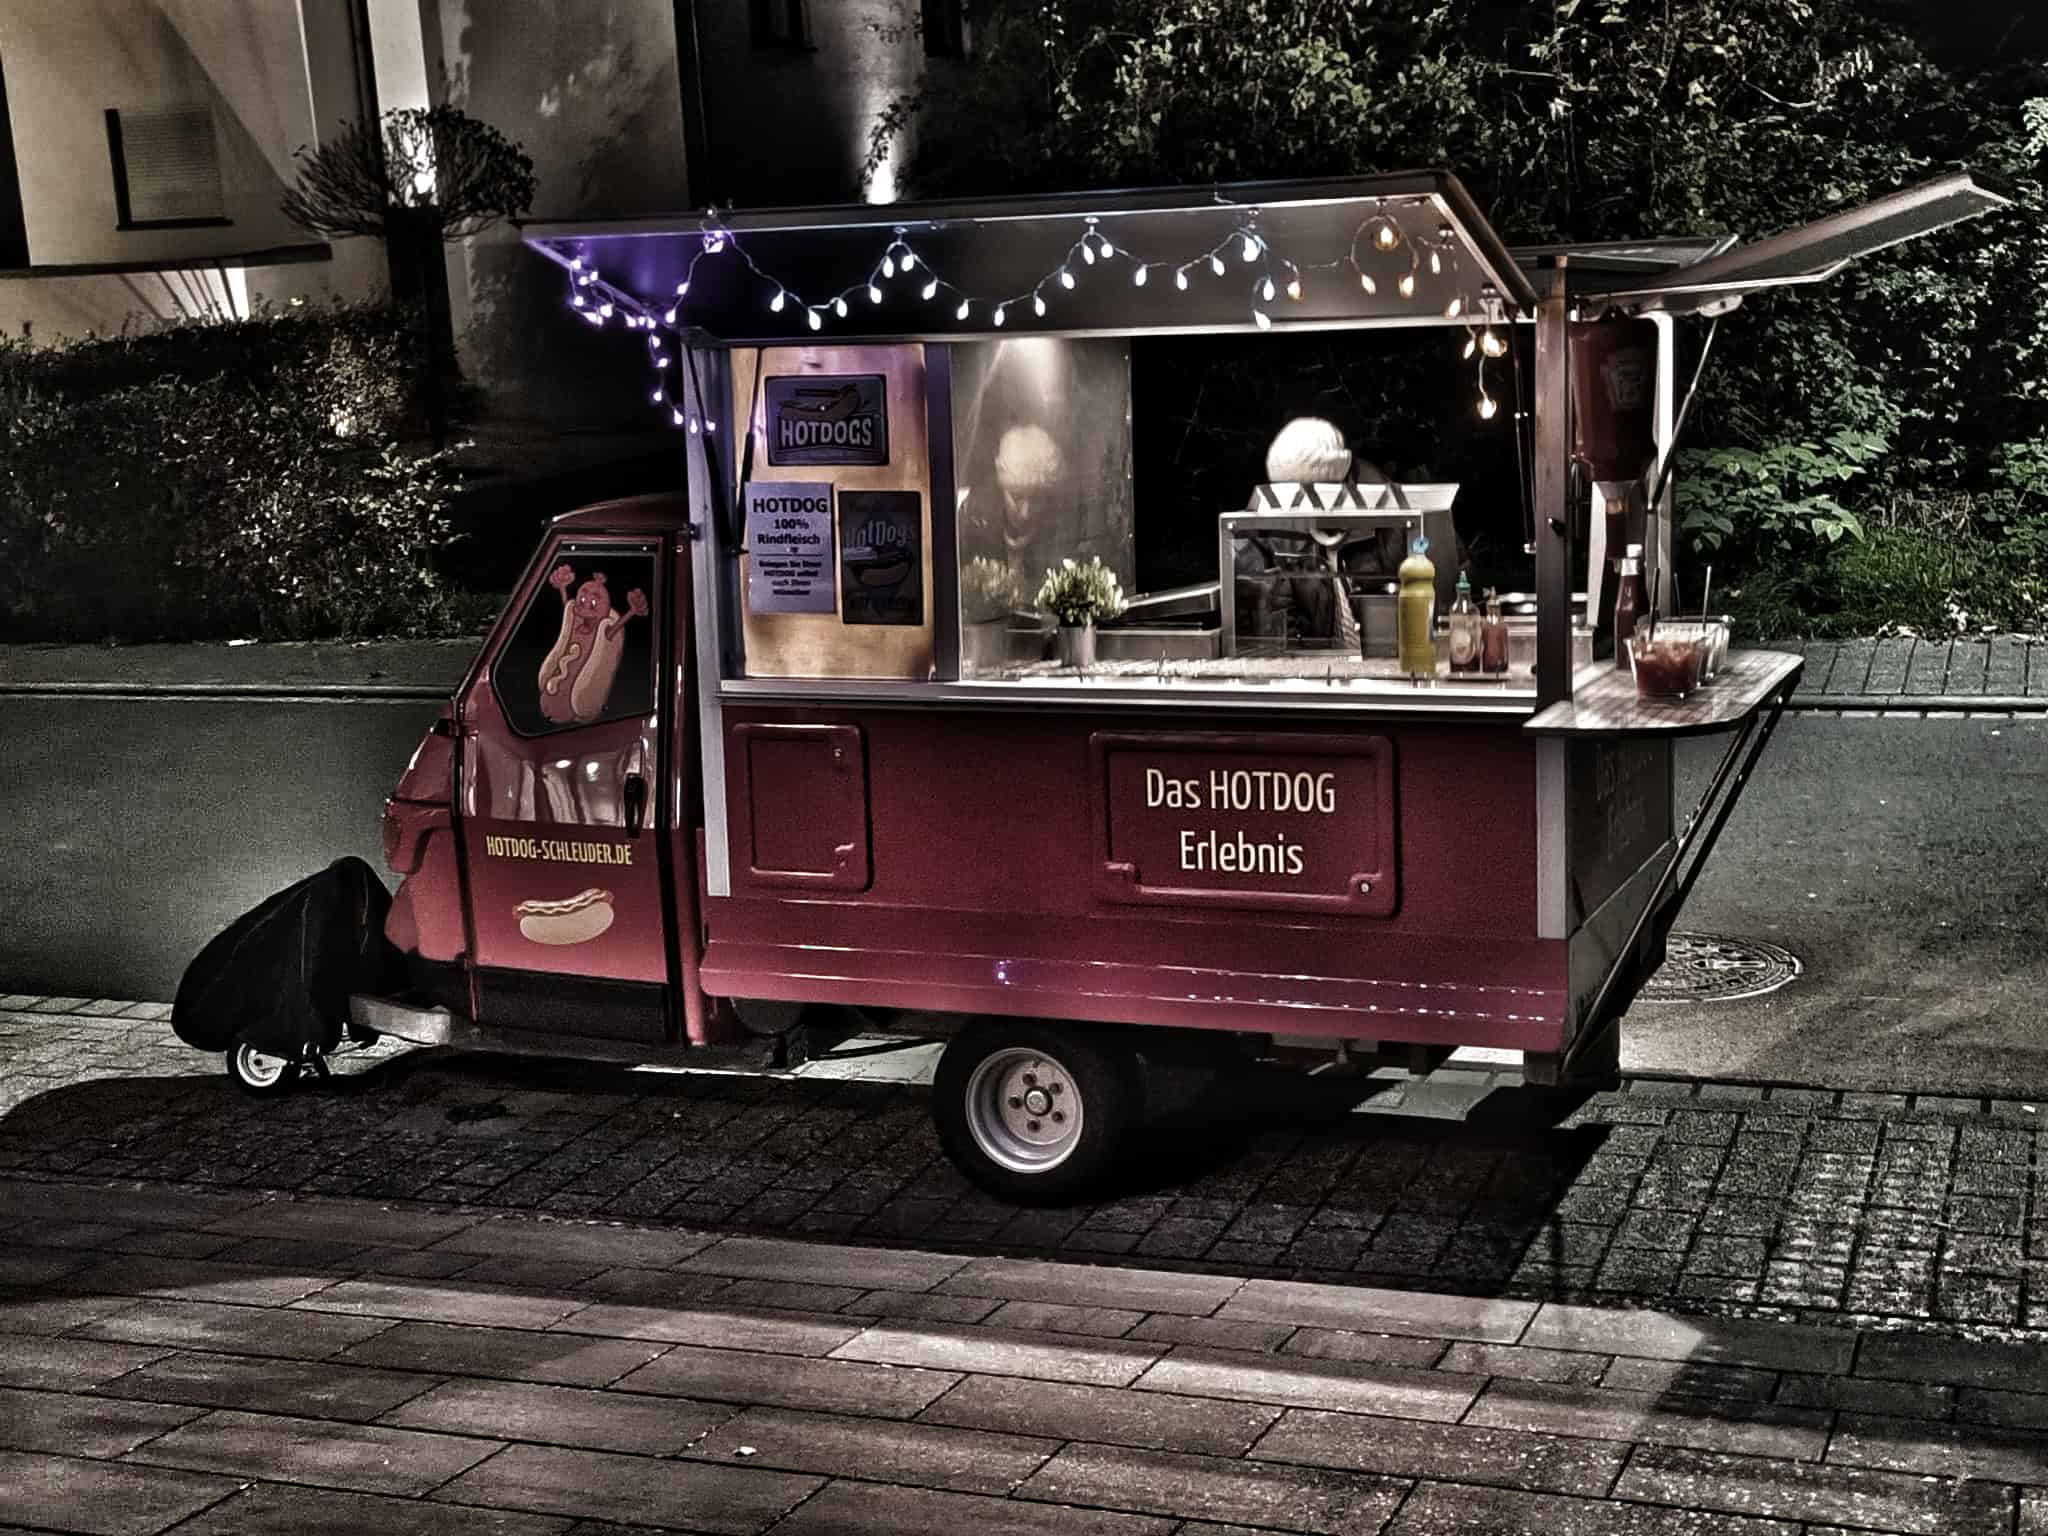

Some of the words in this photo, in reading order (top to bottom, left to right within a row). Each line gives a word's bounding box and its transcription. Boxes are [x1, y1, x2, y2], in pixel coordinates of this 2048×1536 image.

[780, 418, 873, 448] HOTDOGS
[753, 497, 828, 513] HOTDOG
[757, 534, 820, 545] Rindfleisch
[774, 519, 809, 530] 100%
[1146, 768, 1202, 809] Das
[1210, 769, 1336, 813] HOTDOG
[486, 835, 633, 865] HOTDOG-SCHLEUDER.DE
[1179, 830, 1304, 875] Erlebnis
